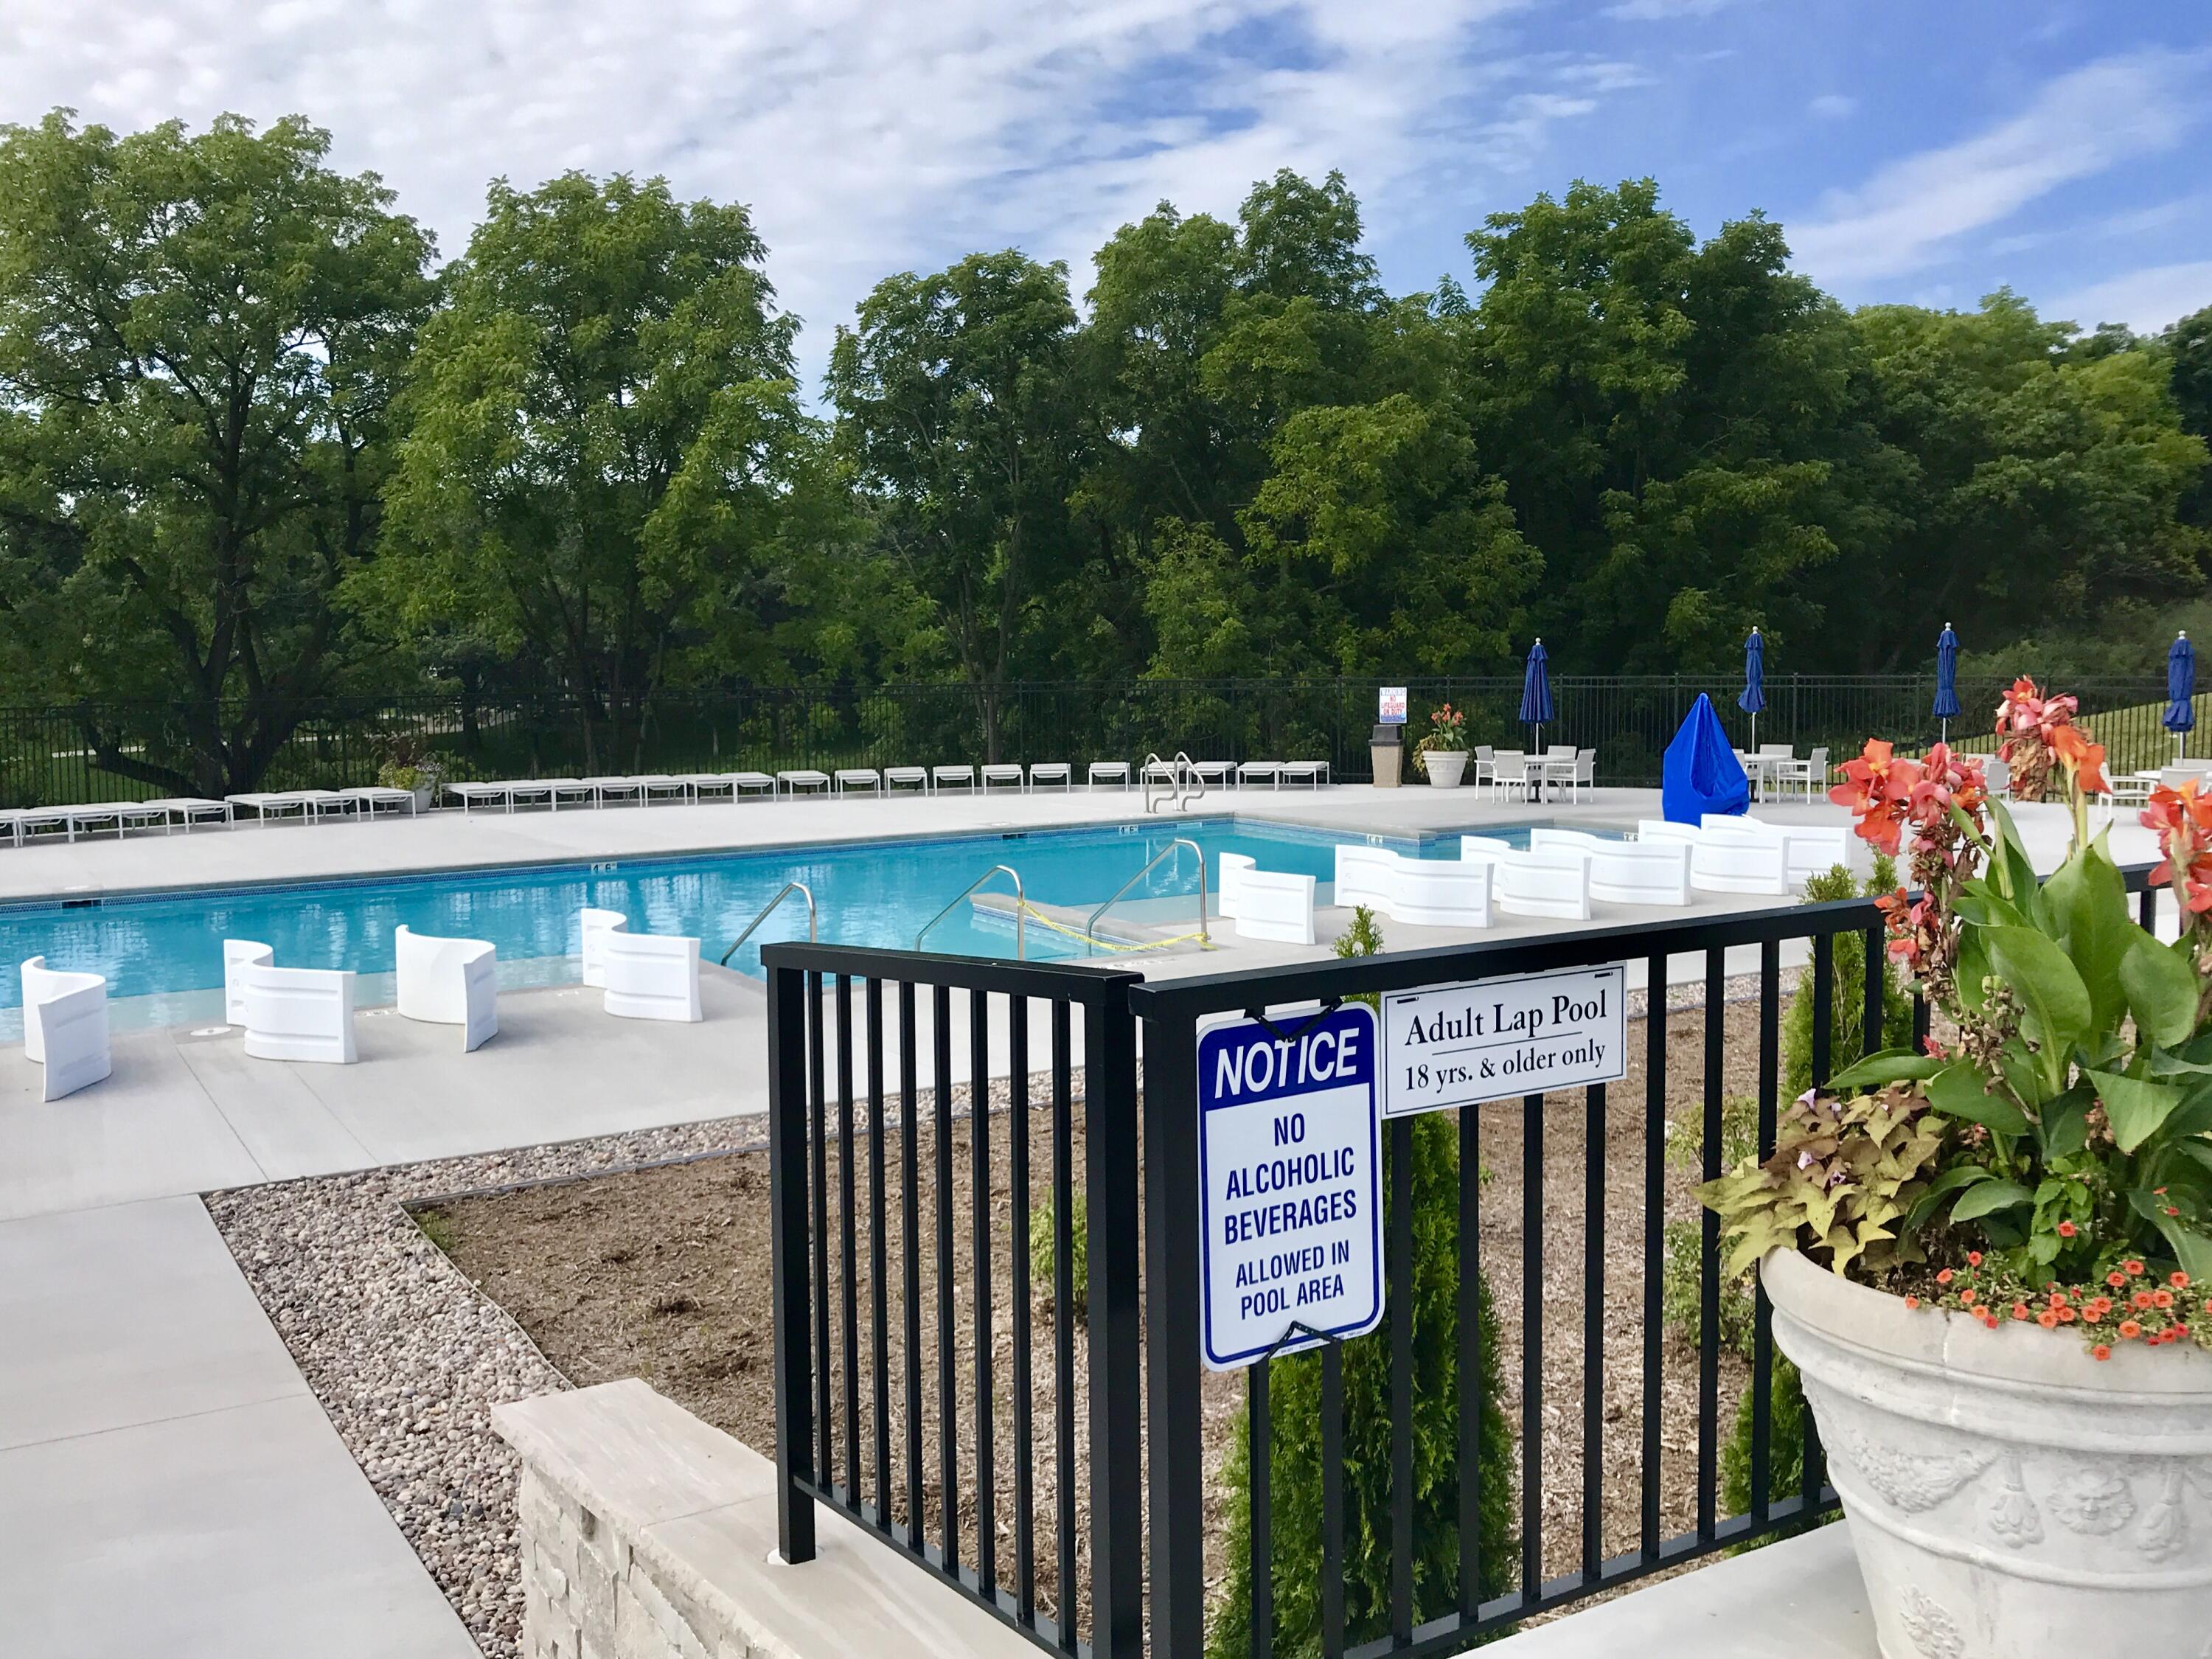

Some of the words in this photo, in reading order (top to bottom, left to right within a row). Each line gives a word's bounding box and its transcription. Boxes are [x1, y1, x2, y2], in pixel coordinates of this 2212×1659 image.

[1405, 1006, 1484, 1046] Adult
[1493, 1004, 1543, 1038] Lap
[1552, 988, 1607, 1025] Pool
[1214, 1027, 1360, 1099] NOTICE
[1405, 1064, 1429, 1091] 18
[1436, 1066, 1473, 1093] yrs.
[1480, 1057, 1496, 1079] &
[1503, 1047, 1557, 1075] older
[1562, 1037, 1606, 1068] only
[1274, 1113, 1305, 1147] NO
[1226, 1147, 1354, 1200] ALCOHOLIC
[1225, 1189, 1357, 1245] BEVERAGES
[1236, 1245, 1324, 1288] ALLOWED
[1332, 1239, 1349, 1265] IN
[1242, 1287, 1290, 1320] POOL
[1296, 1274, 1344, 1307] AREA
